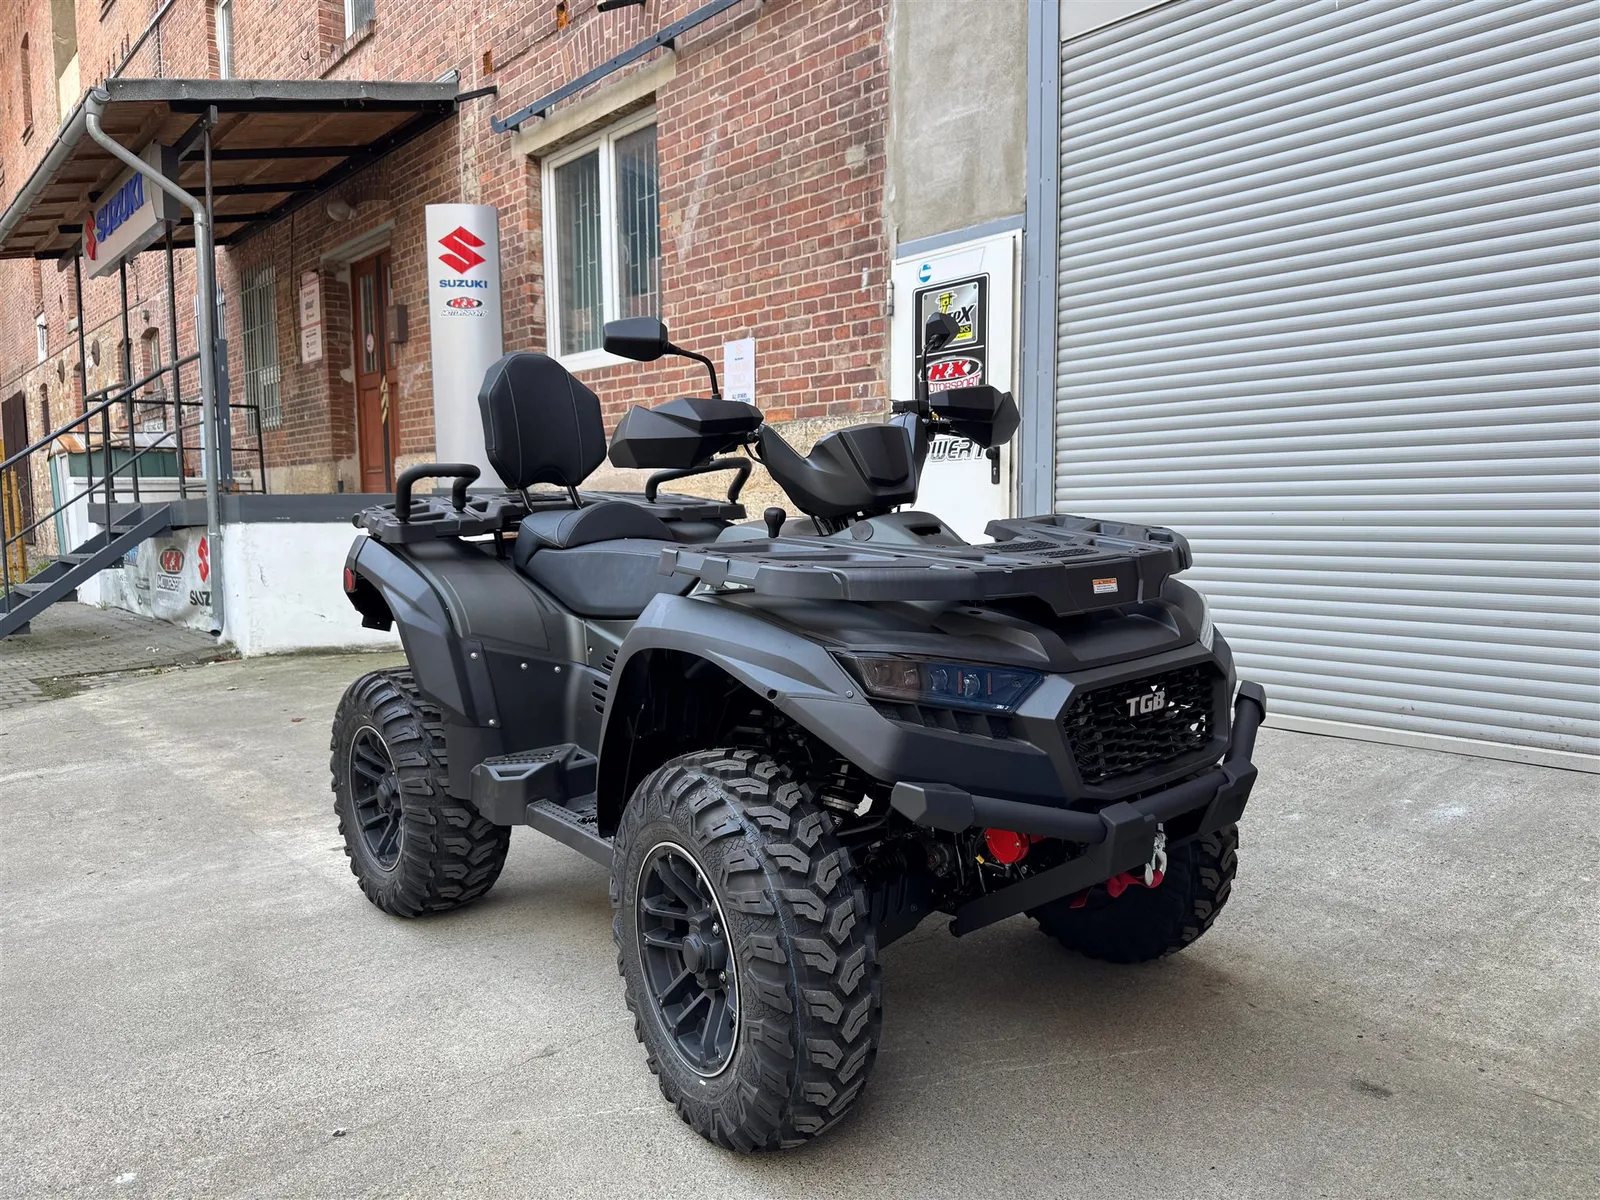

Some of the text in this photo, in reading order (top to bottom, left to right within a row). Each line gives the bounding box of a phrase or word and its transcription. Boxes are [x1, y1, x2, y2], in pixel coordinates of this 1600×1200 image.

[96, 171, 144, 243] SUZUKI
[439, 279, 488, 289] SUZUKI
[928, 374, 981, 393] OTORSPORT
[189, 590, 213, 607] SUZ
[1126, 690, 1166, 717] TGB
